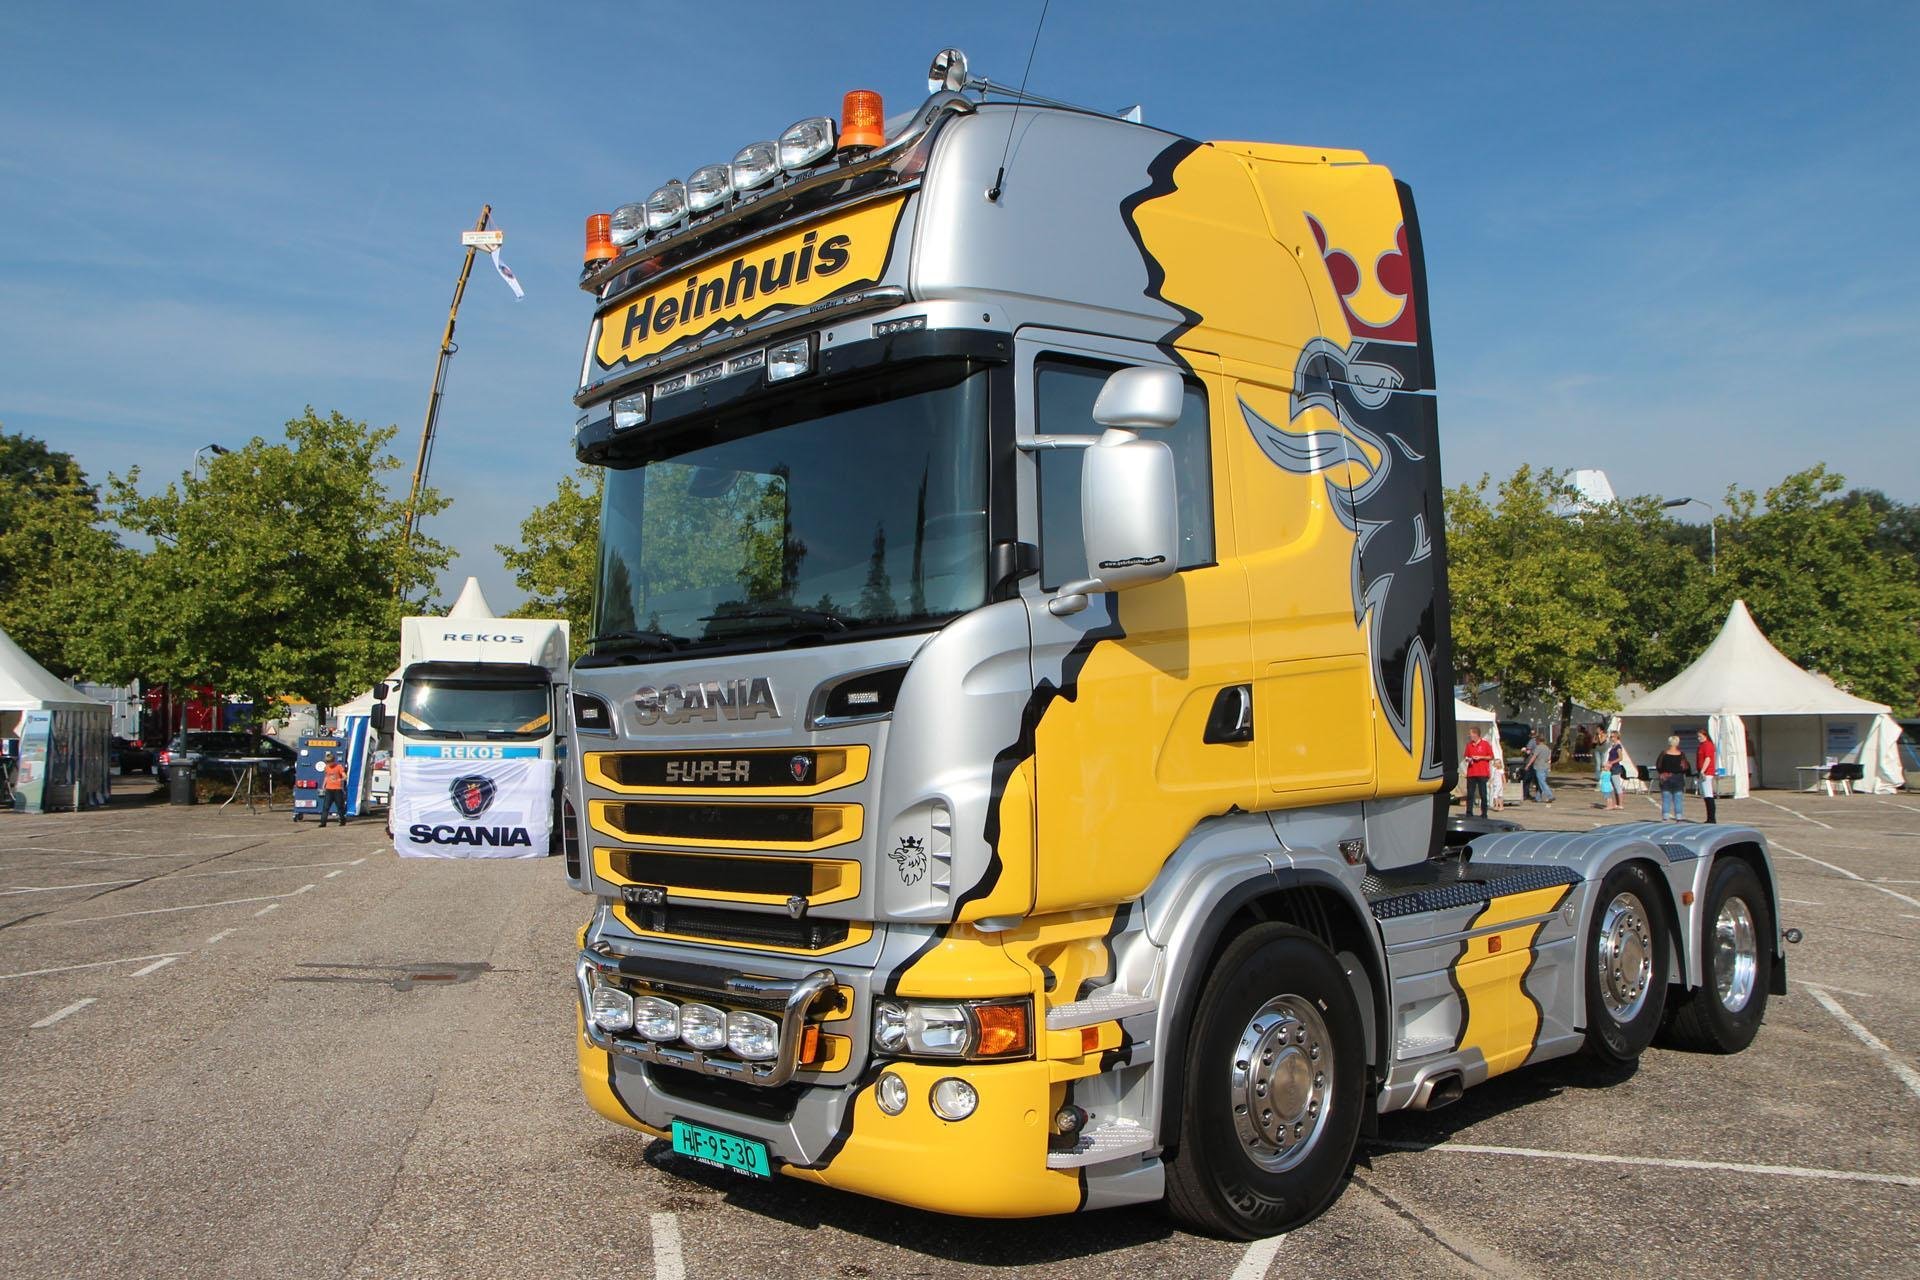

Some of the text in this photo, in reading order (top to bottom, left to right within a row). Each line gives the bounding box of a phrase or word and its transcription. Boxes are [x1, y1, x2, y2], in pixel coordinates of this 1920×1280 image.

[621, 230, 852, 350] Heinhuis
[443, 633, 524, 644] REKOS
[634, 676, 782, 726] SCANIA
[440, 746, 504, 759] REKOS
[665, 759, 751, 782] SUPER
[409, 824, 532, 847] SCANIA
[682, 1126, 757, 1169] HF-95-30
